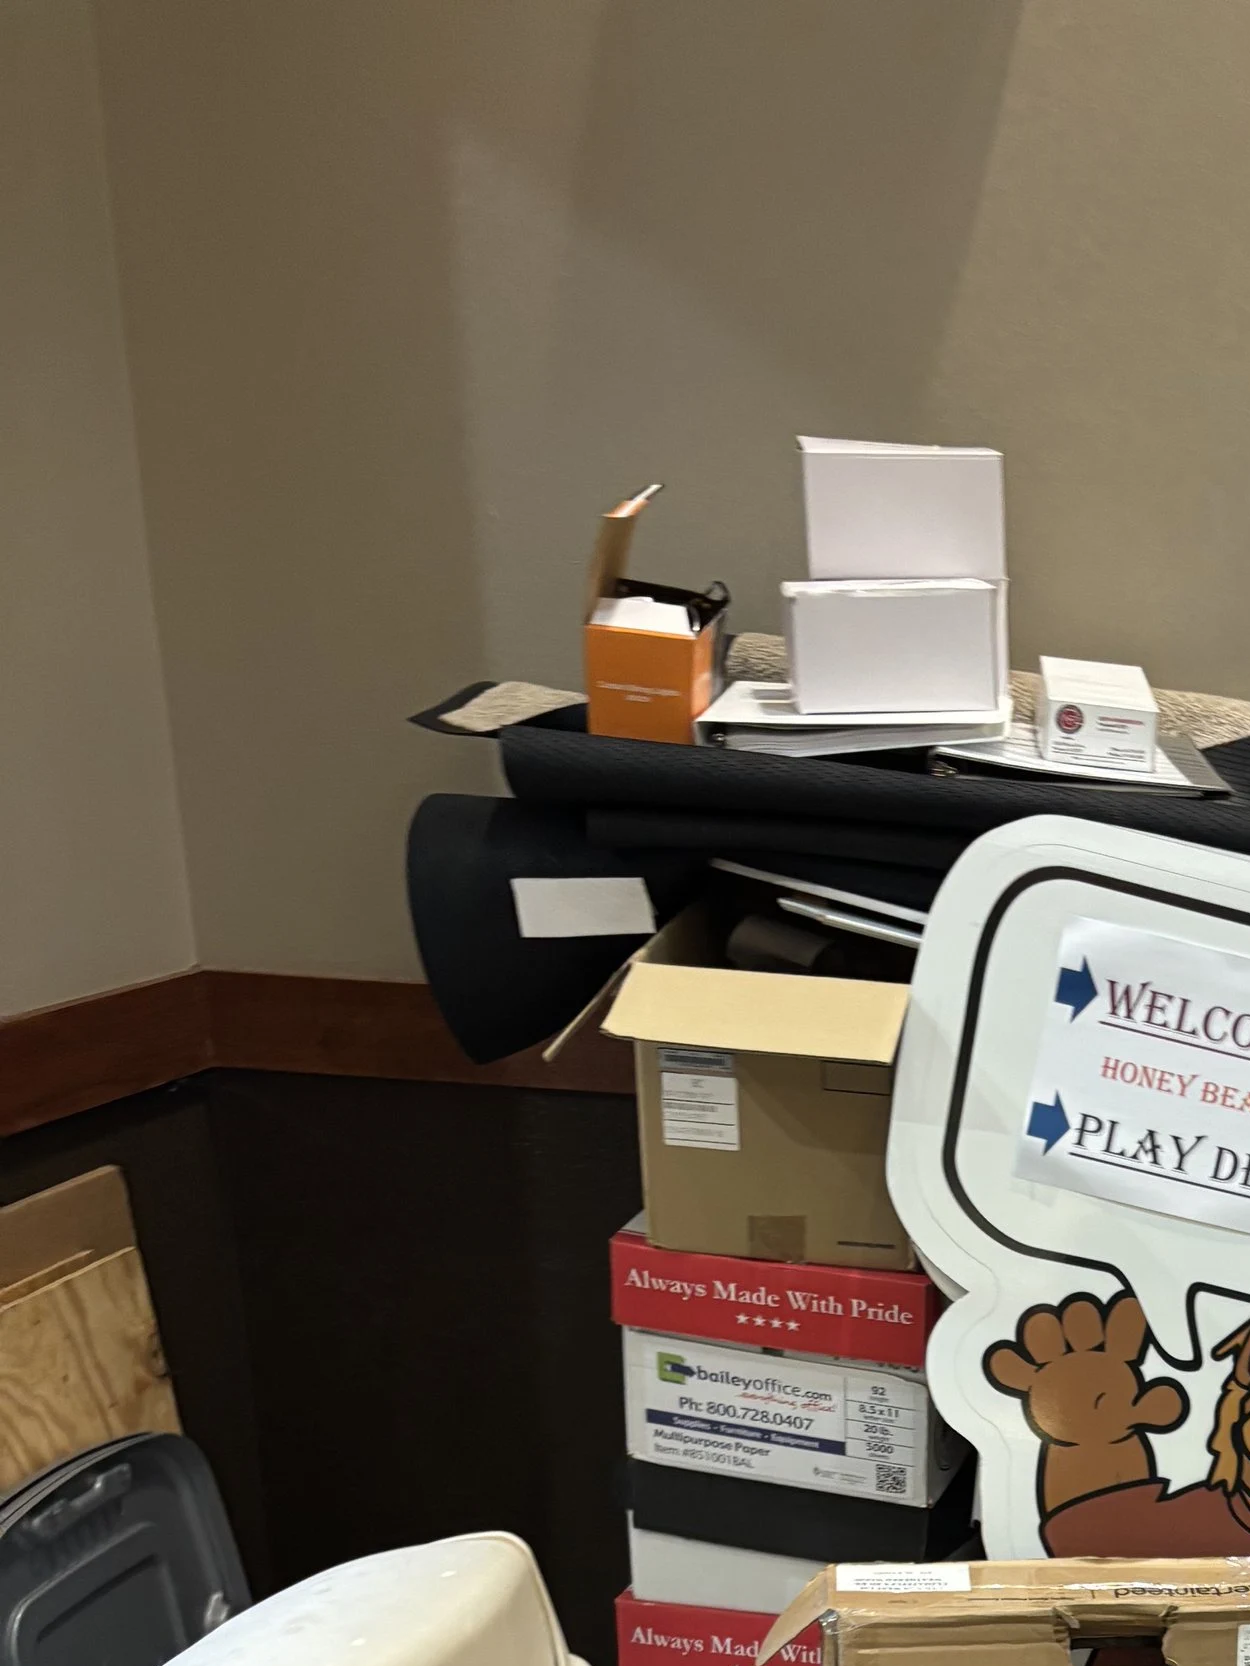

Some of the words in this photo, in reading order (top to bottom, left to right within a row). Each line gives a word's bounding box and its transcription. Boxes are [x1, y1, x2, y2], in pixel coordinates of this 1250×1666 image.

[1100, 1056, 1200, 1098] HONEY
[1074, 1112, 1208, 1173] PLAY
[624, 1268, 707, 1300] Always
[712, 1280, 780, 1308] Made
[786, 1290, 844, 1316] With
[850, 1298, 913, 1326] Pride
[696, 1365, 832, 1401] baileyoffice.com
[871, 1386, 886, 1396] 92
[679, 1396, 702, 1411] Ph:
[706, 1401, 815, 1431] 800.728.0407
[653, 1429, 734, 1451] Multipurpose
[734, 1443, 771, 1457] Paper
[630, 1626, 704, 1655] Always
[710, 1635, 759, 1659] Mad
